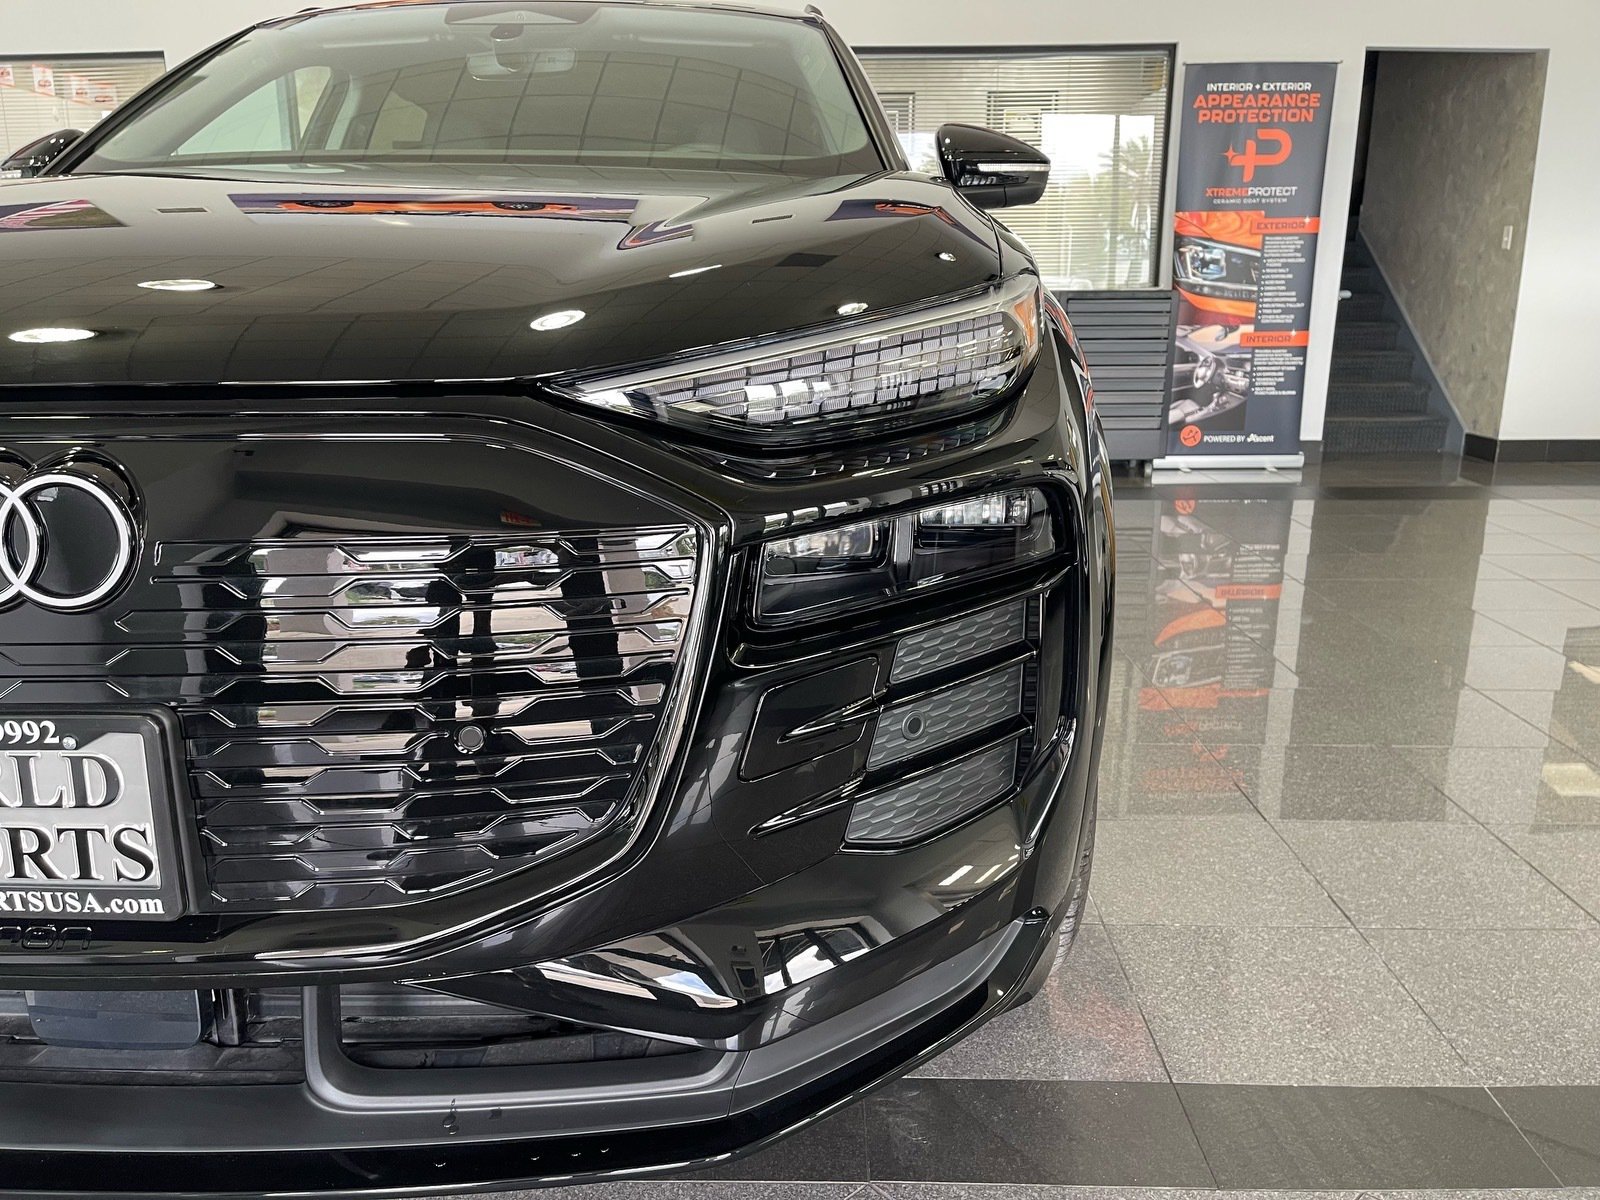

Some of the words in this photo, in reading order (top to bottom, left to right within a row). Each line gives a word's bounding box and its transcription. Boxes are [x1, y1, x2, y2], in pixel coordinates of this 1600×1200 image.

[1207, 83, 1253, 91] INTERIOR
[1262, 82, 1312, 91] EXTERIOR
[1193, 93, 1321, 108] APPEARANCE
[1198, 109, 1314, 123] PROTECTION
[1206, 187, 1298, 197] XTREMEPROTECT
[1246, 335, 1291, 343] INTERIOR
[0, 720, 60, 744] 992
[0, 751, 124, 808] LD
[0, 825, 154, 882] RTS
